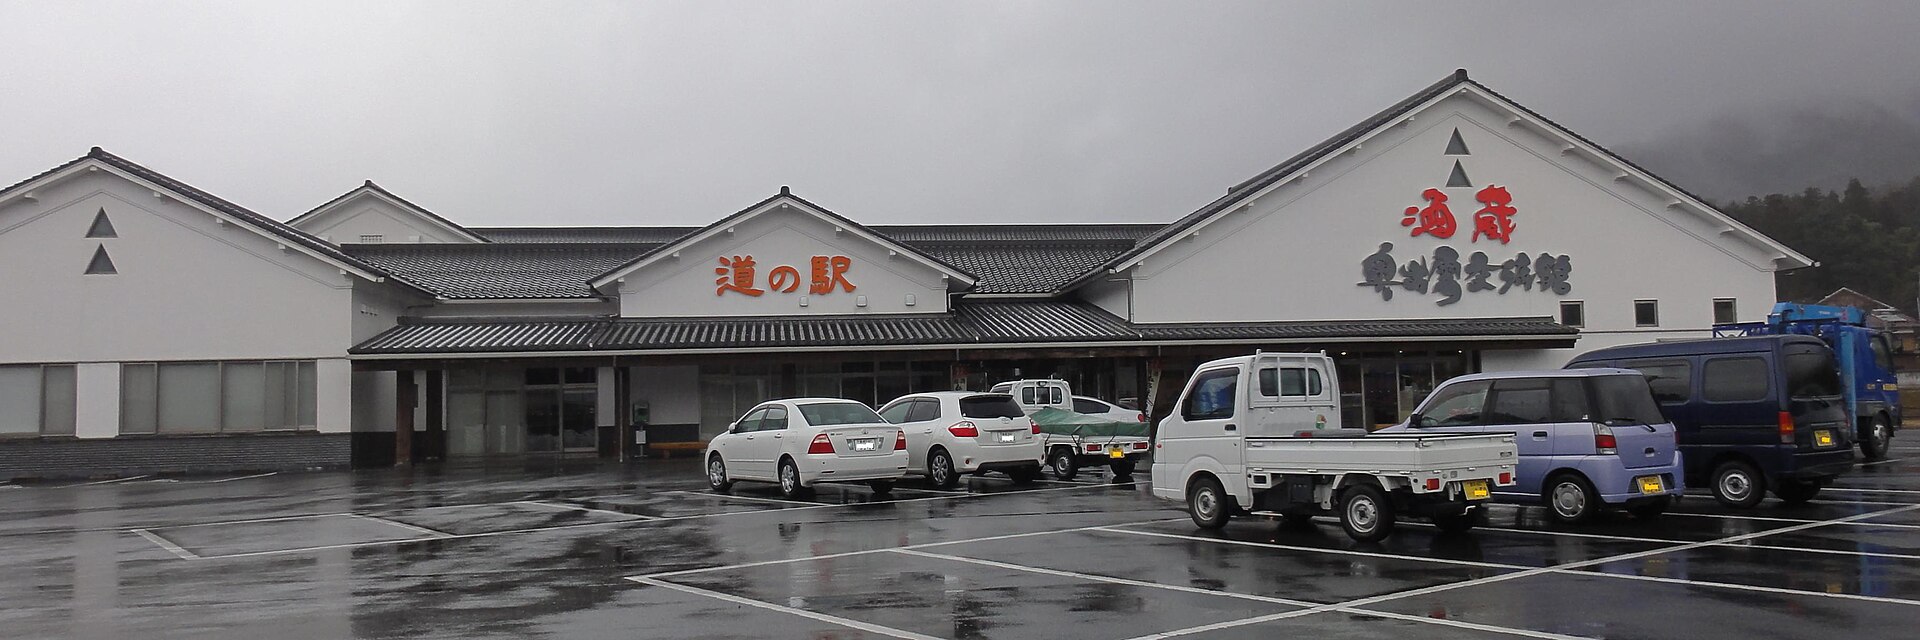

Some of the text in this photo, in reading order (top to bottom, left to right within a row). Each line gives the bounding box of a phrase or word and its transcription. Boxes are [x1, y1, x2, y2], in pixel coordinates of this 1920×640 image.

[1401, 185, 1518, 244] 酒蔵
[715, 255, 857, 297] 道の駅
